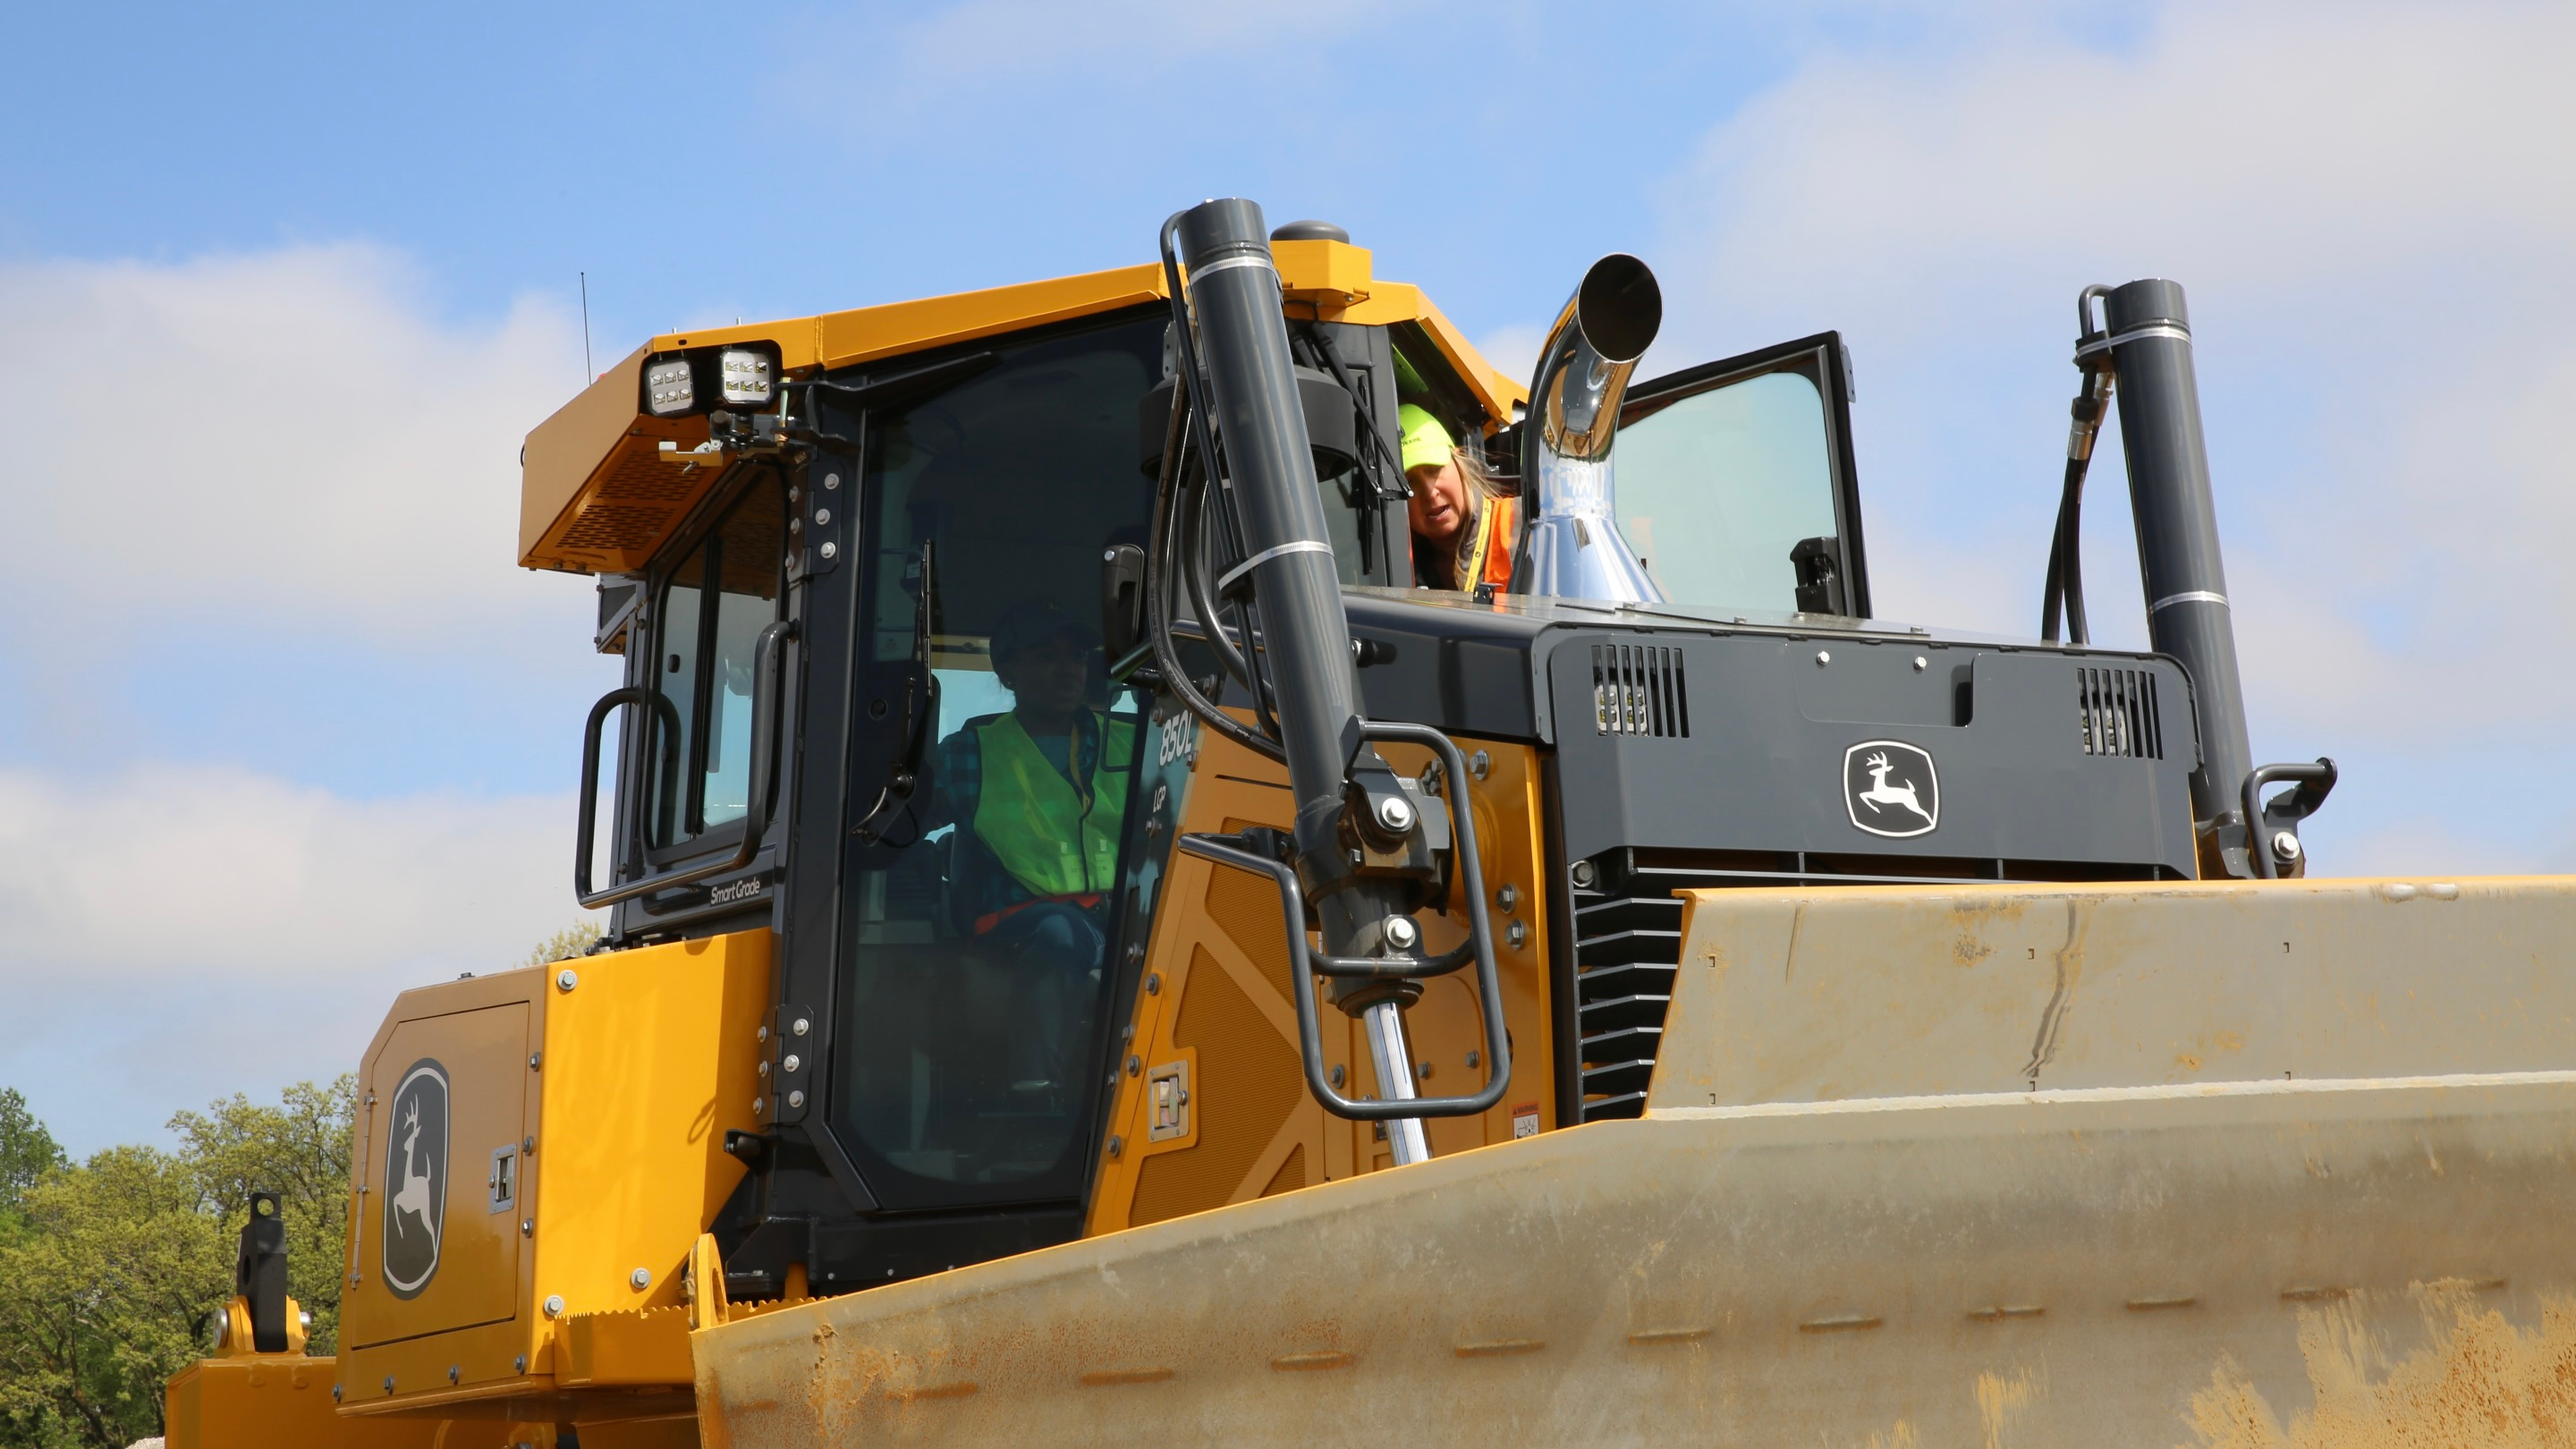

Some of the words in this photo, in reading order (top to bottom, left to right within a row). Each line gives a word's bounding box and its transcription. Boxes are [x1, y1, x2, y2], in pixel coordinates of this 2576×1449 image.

[1159, 709, 1192, 767] 850L
[1153, 785, 1166, 813] LGP
[711, 884, 735, 904] Smart
[736, 877, 760, 899] Grade
[1517, 1102, 1538, 1114] WARNING
